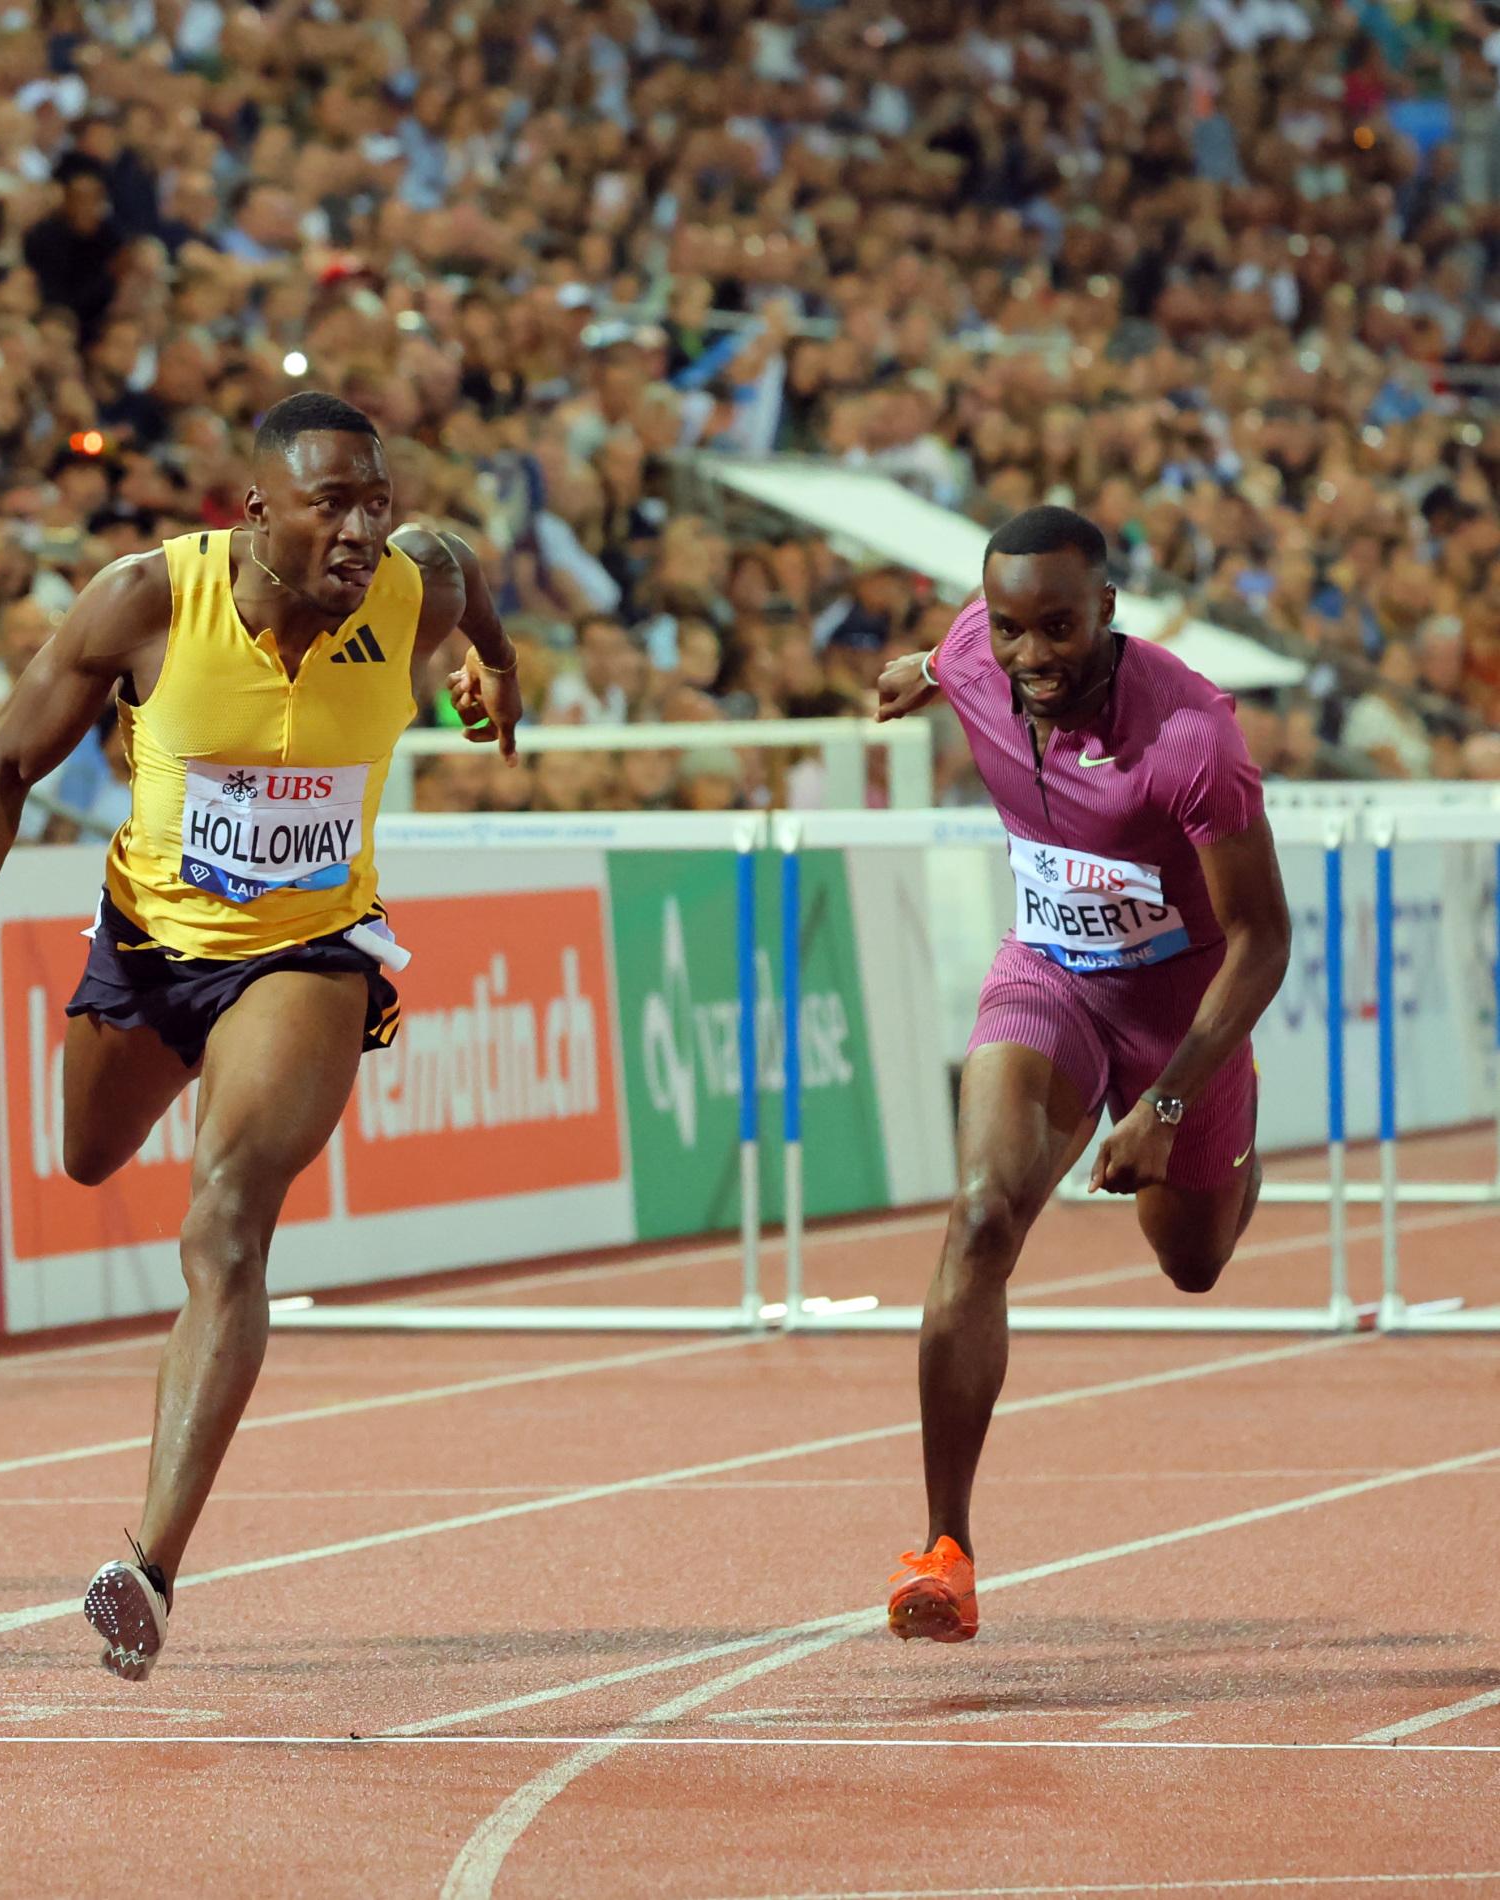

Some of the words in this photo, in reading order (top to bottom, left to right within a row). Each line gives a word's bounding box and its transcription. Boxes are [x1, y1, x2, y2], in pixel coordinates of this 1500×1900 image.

[266, 775, 333, 800] UBS
[190, 810, 355, 865] HOLLOWAY
[1065, 859, 1126, 892] UBS
[1025, 887, 1169, 937] ROBERTS
[1065, 946, 1156, 968] LAUSANNE
